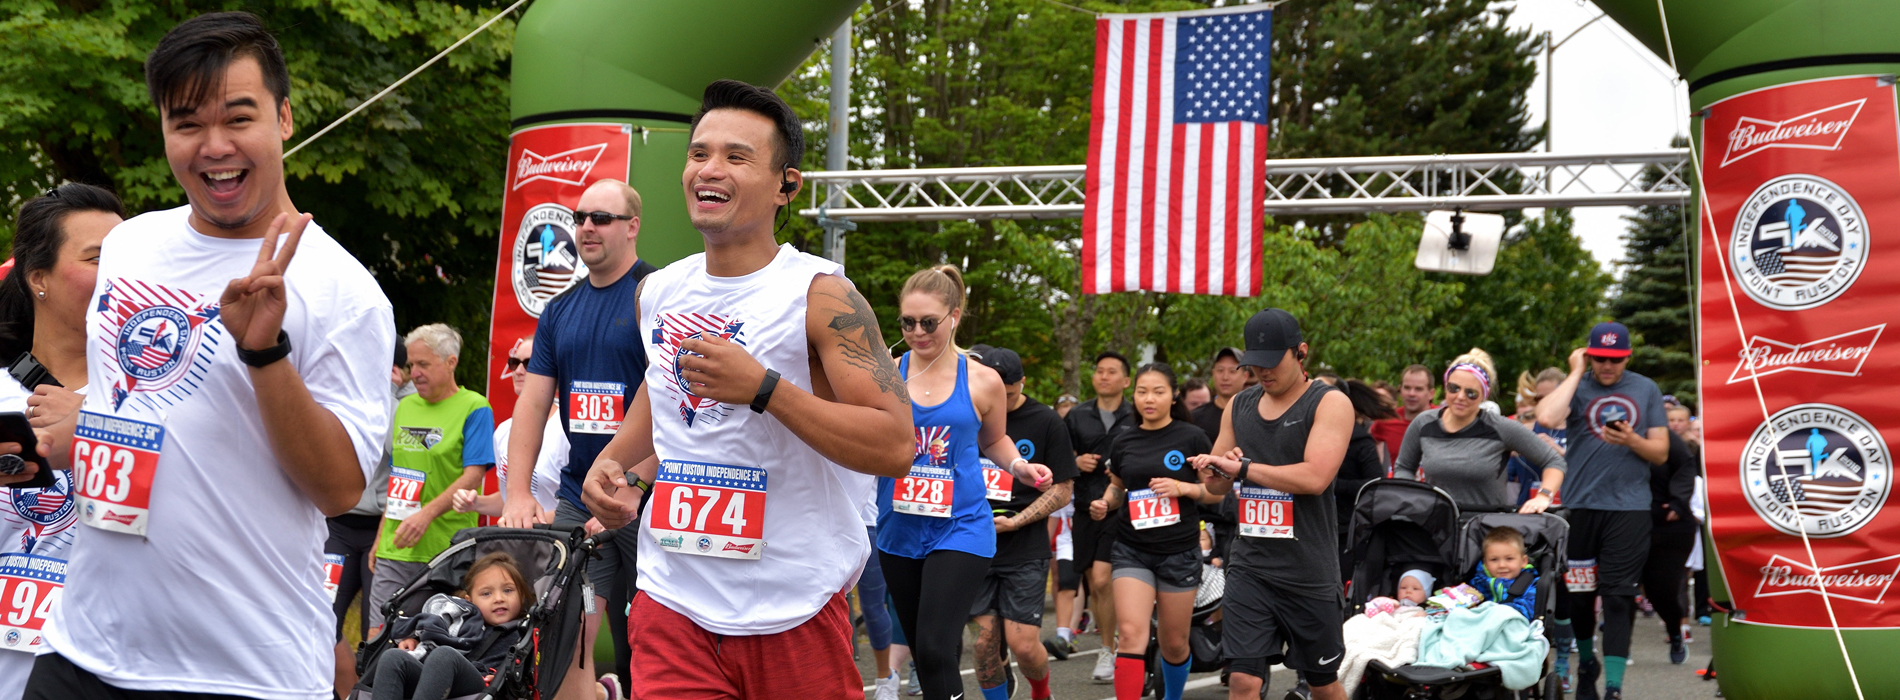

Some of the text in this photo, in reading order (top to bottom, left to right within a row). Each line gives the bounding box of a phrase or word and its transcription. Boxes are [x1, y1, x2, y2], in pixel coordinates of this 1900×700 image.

[1729, 117, 1850, 153] Budweiser
[517, 156, 592, 179] Budweiser
[1738, 182, 1861, 248] INDEPENDENCE DAY
[1744, 257, 1857, 301] POINT RUSTON
[518, 280, 538, 309] POINT
[123, 309, 187, 336] INDEPENDENCE
[178, 329, 188, 348] DAY
[120, 346, 176, 377] POINT RUSTON
[1738, 343, 1870, 371] Budweiser
[577, 394, 615, 421] 303
[1749, 411, 1884, 472] INDEPENDENCE DAY
[74, 440, 135, 503] 683
[664, 461, 683, 475] POINT
[682, 463, 706, 477] RUSTON
[705, 465, 752, 481] INDEPENDENCE
[390, 477, 418, 501] 270
[902, 477, 944, 504] 328
[16, 498, 73, 521] POINT RUSTON
[668, 485, 747, 535] 674
[1137, 497, 1172, 519] 178
[1245, 499, 1284, 526] 609
[1759, 488, 1879, 531] POINT RUSTON
[6, 556, 30, 569] RUSTON
[28, 557, 68, 575] INDEPENDEN
[1567, 568, 1596, 584] 466
[1760, 566, 1893, 588] Budweiser
